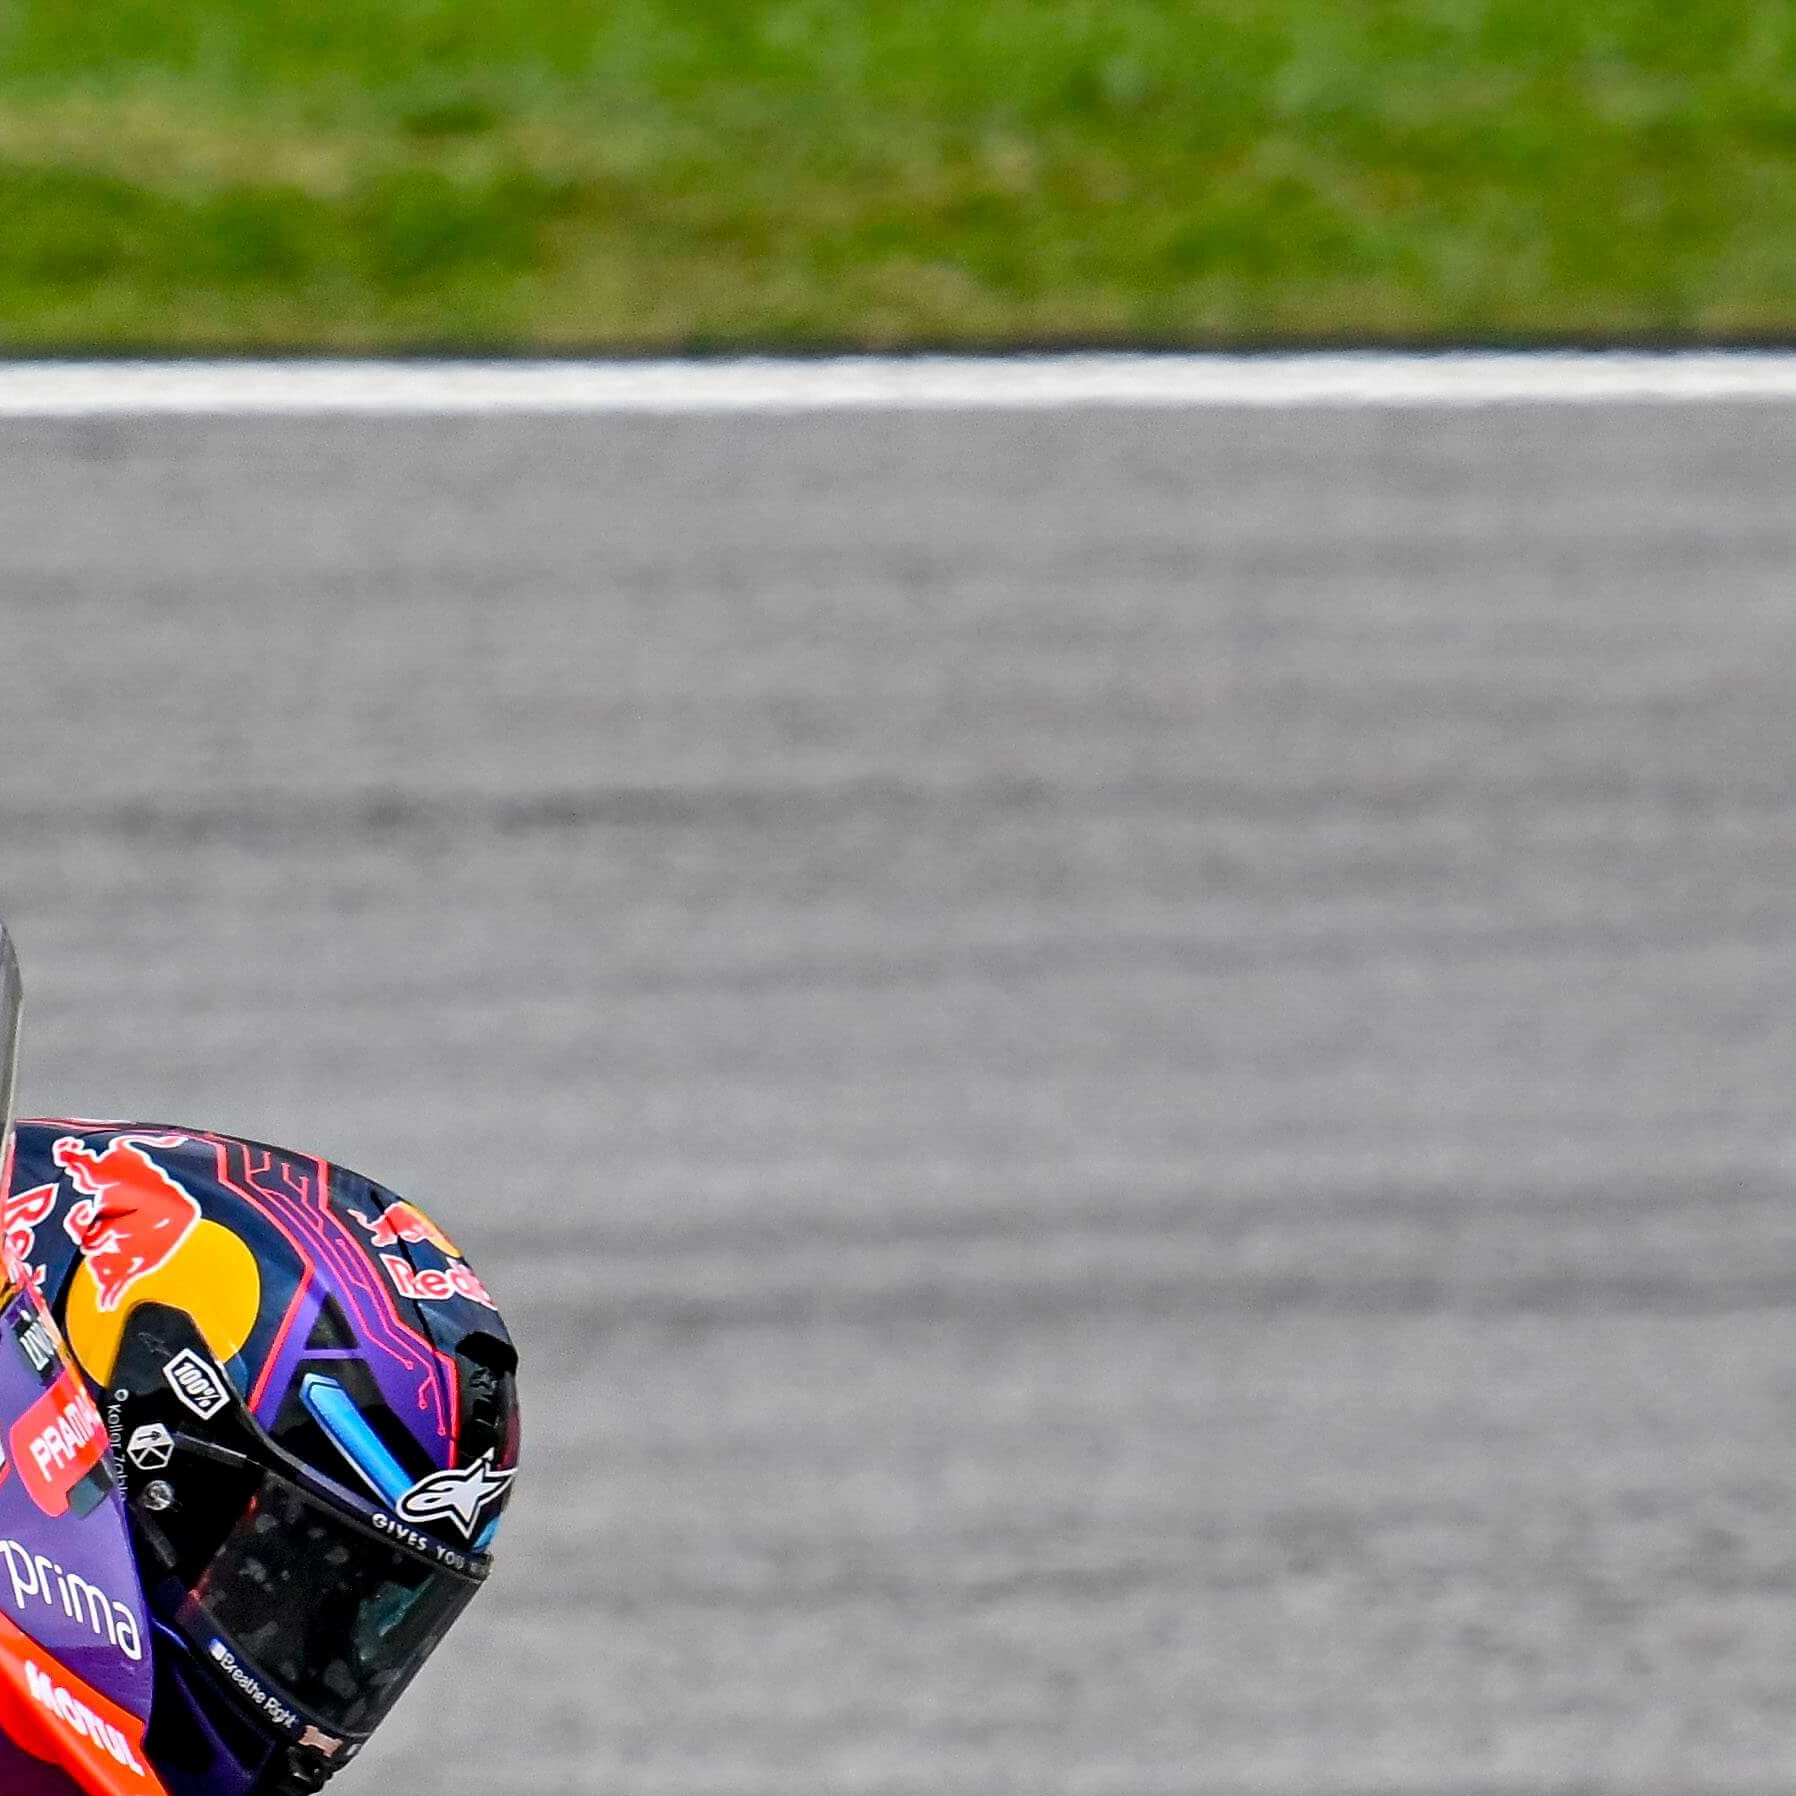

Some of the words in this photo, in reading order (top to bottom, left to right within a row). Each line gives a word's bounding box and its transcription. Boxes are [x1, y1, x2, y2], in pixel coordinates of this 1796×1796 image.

[175, 1358, 224, 1411] 100%
[371, 1512, 428, 1552] GIVES
[23, 1658, 146, 1778] MOTUL
[220, 1650, 269, 1706] Breathe
[263, 1697, 299, 1730] Right
